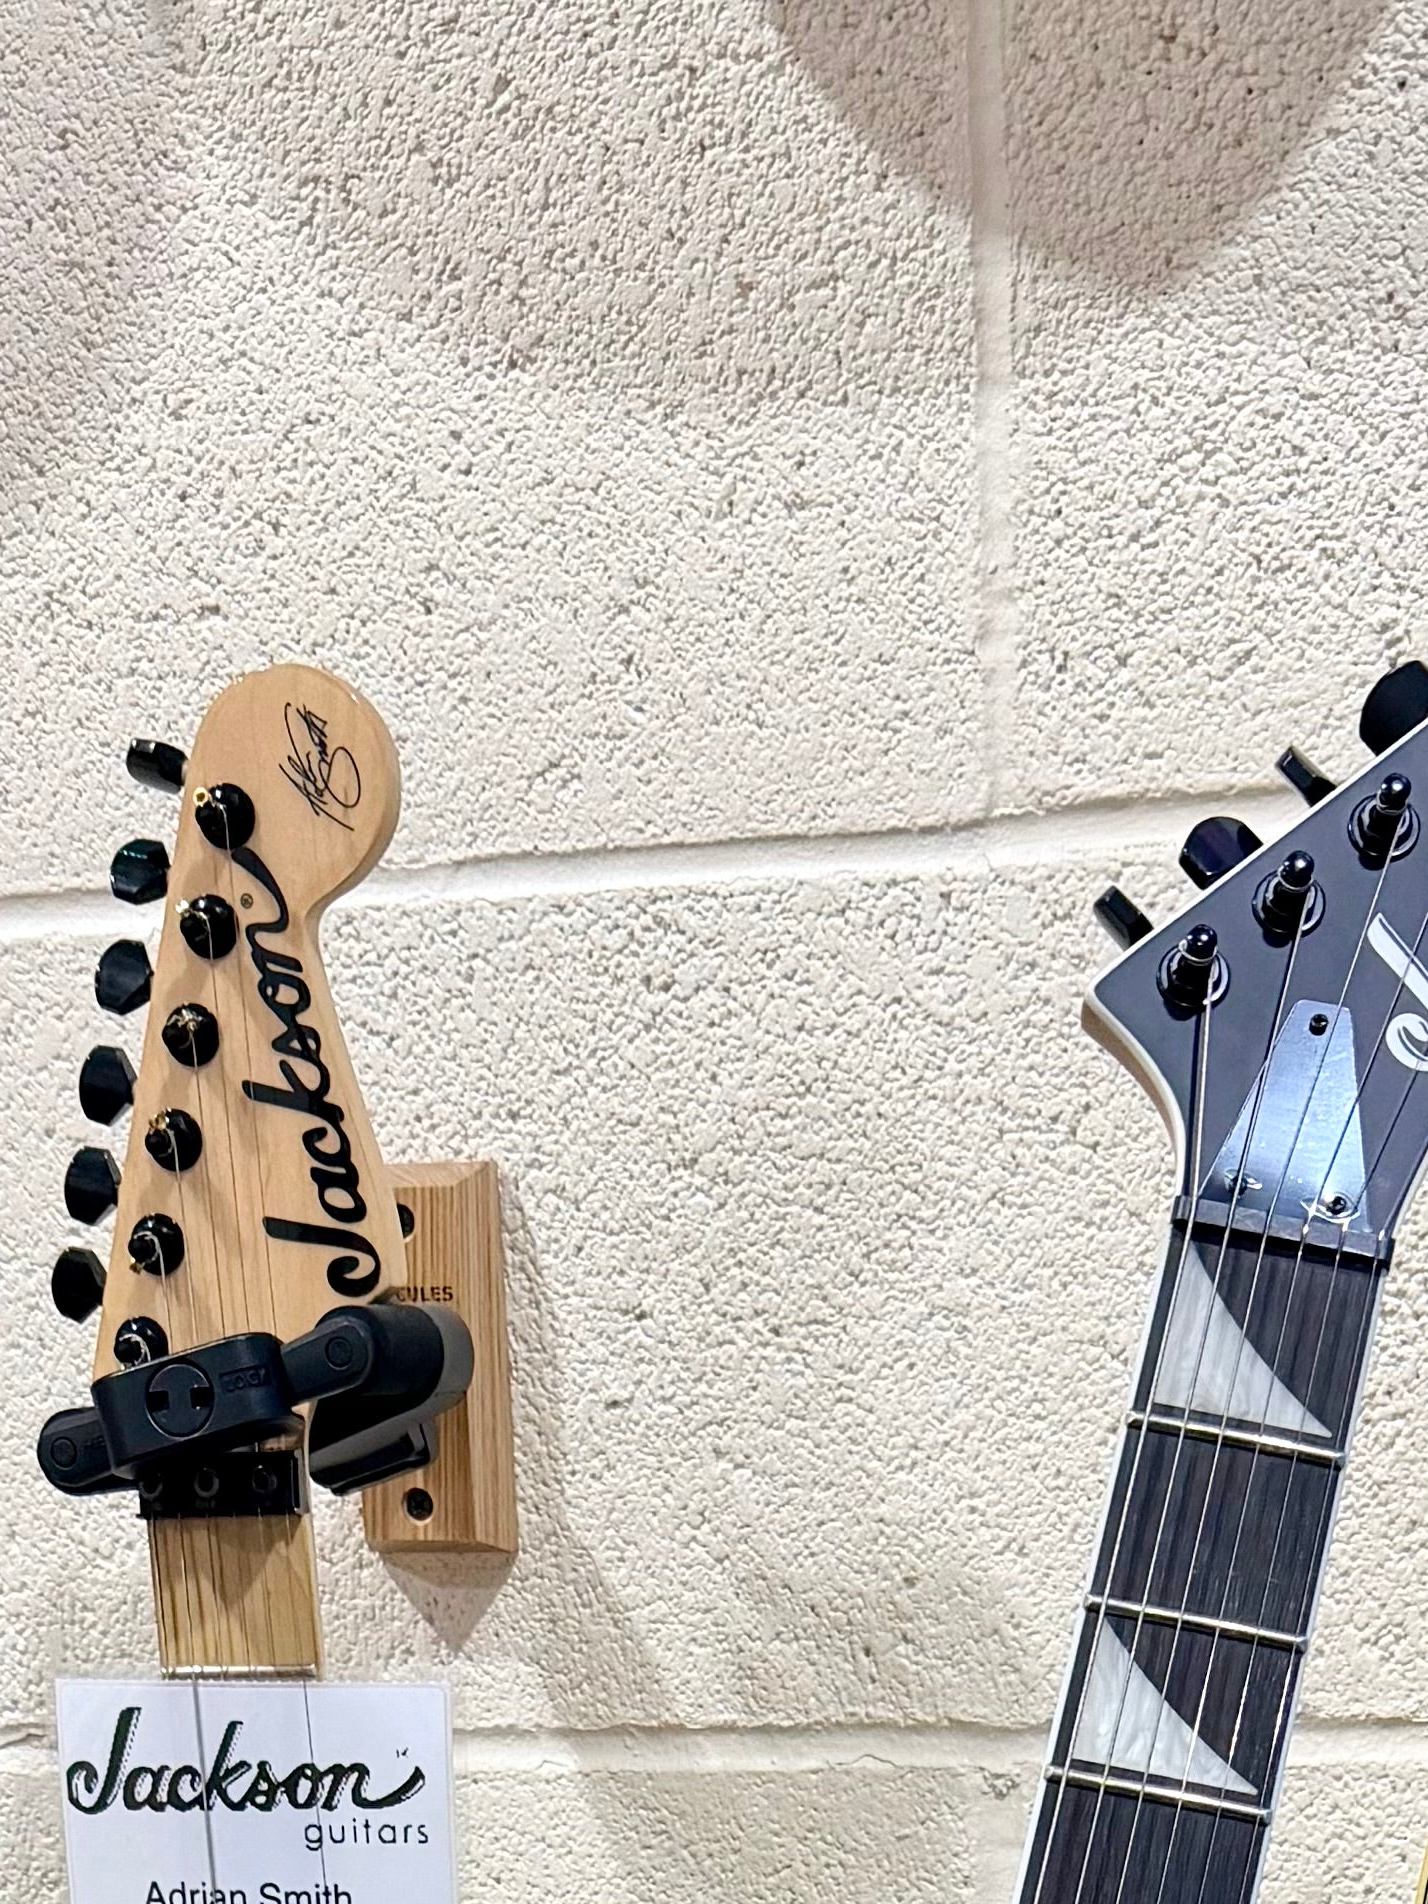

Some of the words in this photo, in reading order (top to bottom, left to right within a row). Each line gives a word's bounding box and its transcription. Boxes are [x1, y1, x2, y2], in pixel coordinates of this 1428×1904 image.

[232, 846, 382, 1298] Jackson
[66, 1706, 426, 1815] Jackson
[304, 1817, 429, 1851] guitars
